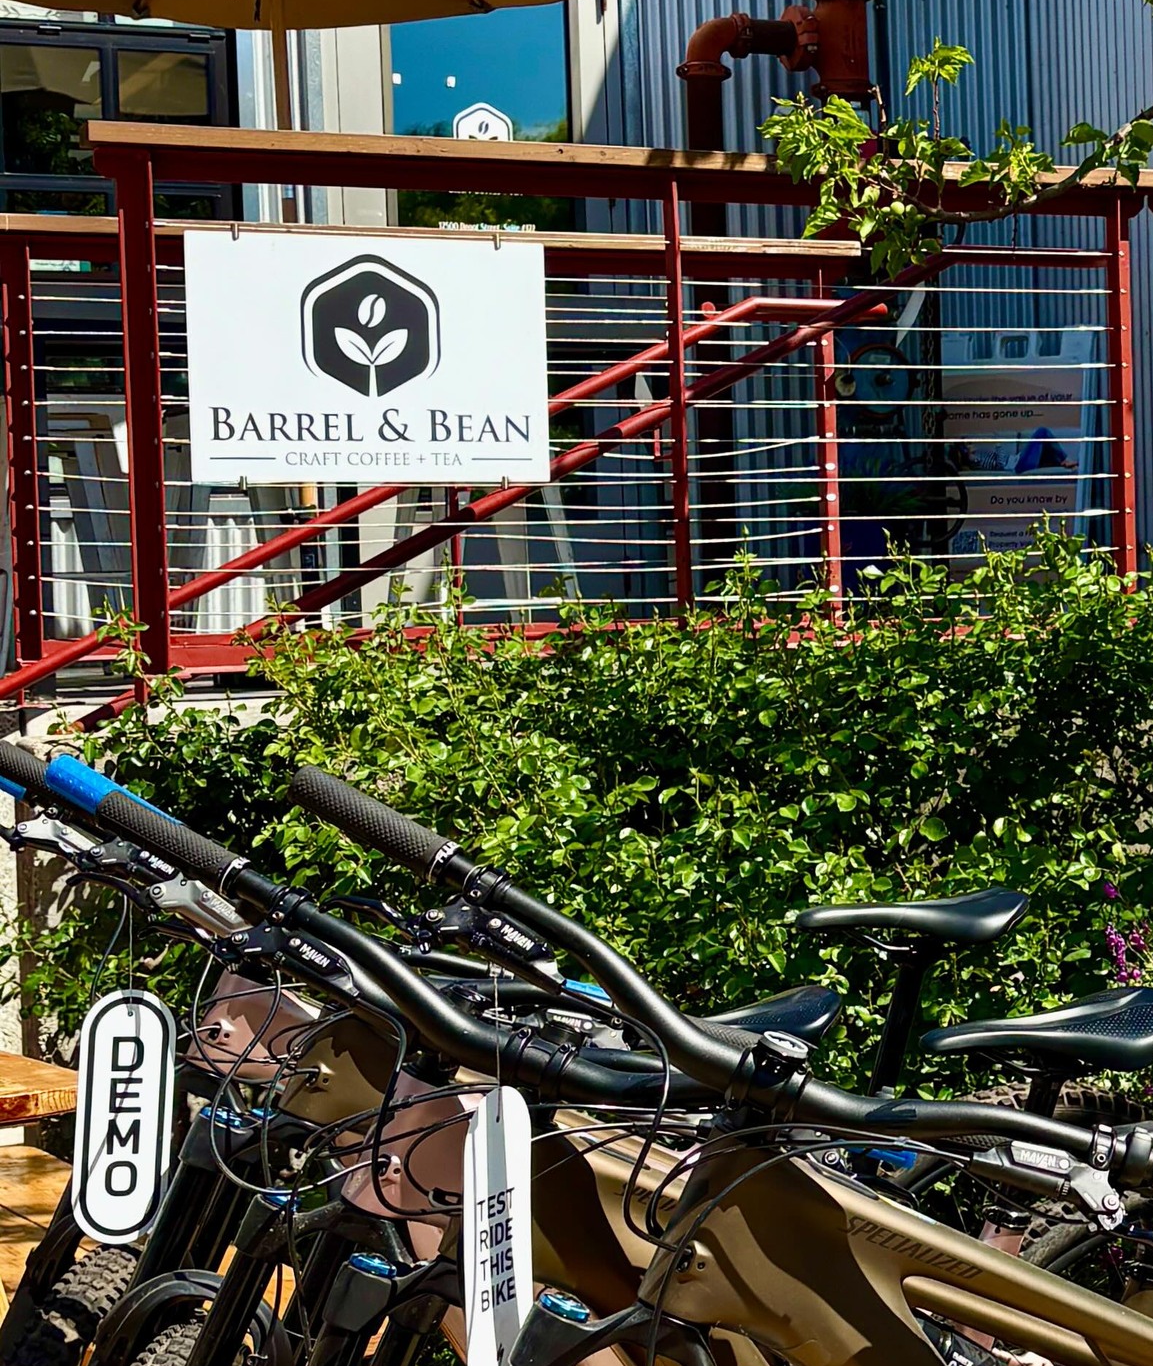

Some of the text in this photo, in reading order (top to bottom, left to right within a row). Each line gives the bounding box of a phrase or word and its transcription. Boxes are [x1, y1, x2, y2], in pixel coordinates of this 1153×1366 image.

[208, 406, 531, 443] BARREL & BEAN
[972, 409, 991, 419] has
[992, 408, 1018, 420] gone
[285, 451, 342, 466] CRAFT
[347, 451, 410, 466] COFFEE
[430, 453, 462, 466] TEA
[990, 494, 1068, 506] Do you know by
[298, 941, 330, 969] MAVEN
[500, 924, 535, 952] MAVEN
[104, 1036, 145, 1197] DEMO
[1019, 1148, 1057, 1169] MAVEN
[476, 1187, 515, 1223] TEST
[479, 1217, 513, 1253] RIDE
[838, 1216, 984, 1279] SPECIALIZED
[480, 1247, 514, 1282] THIS
[481, 1277, 517, 1313] BIKE
